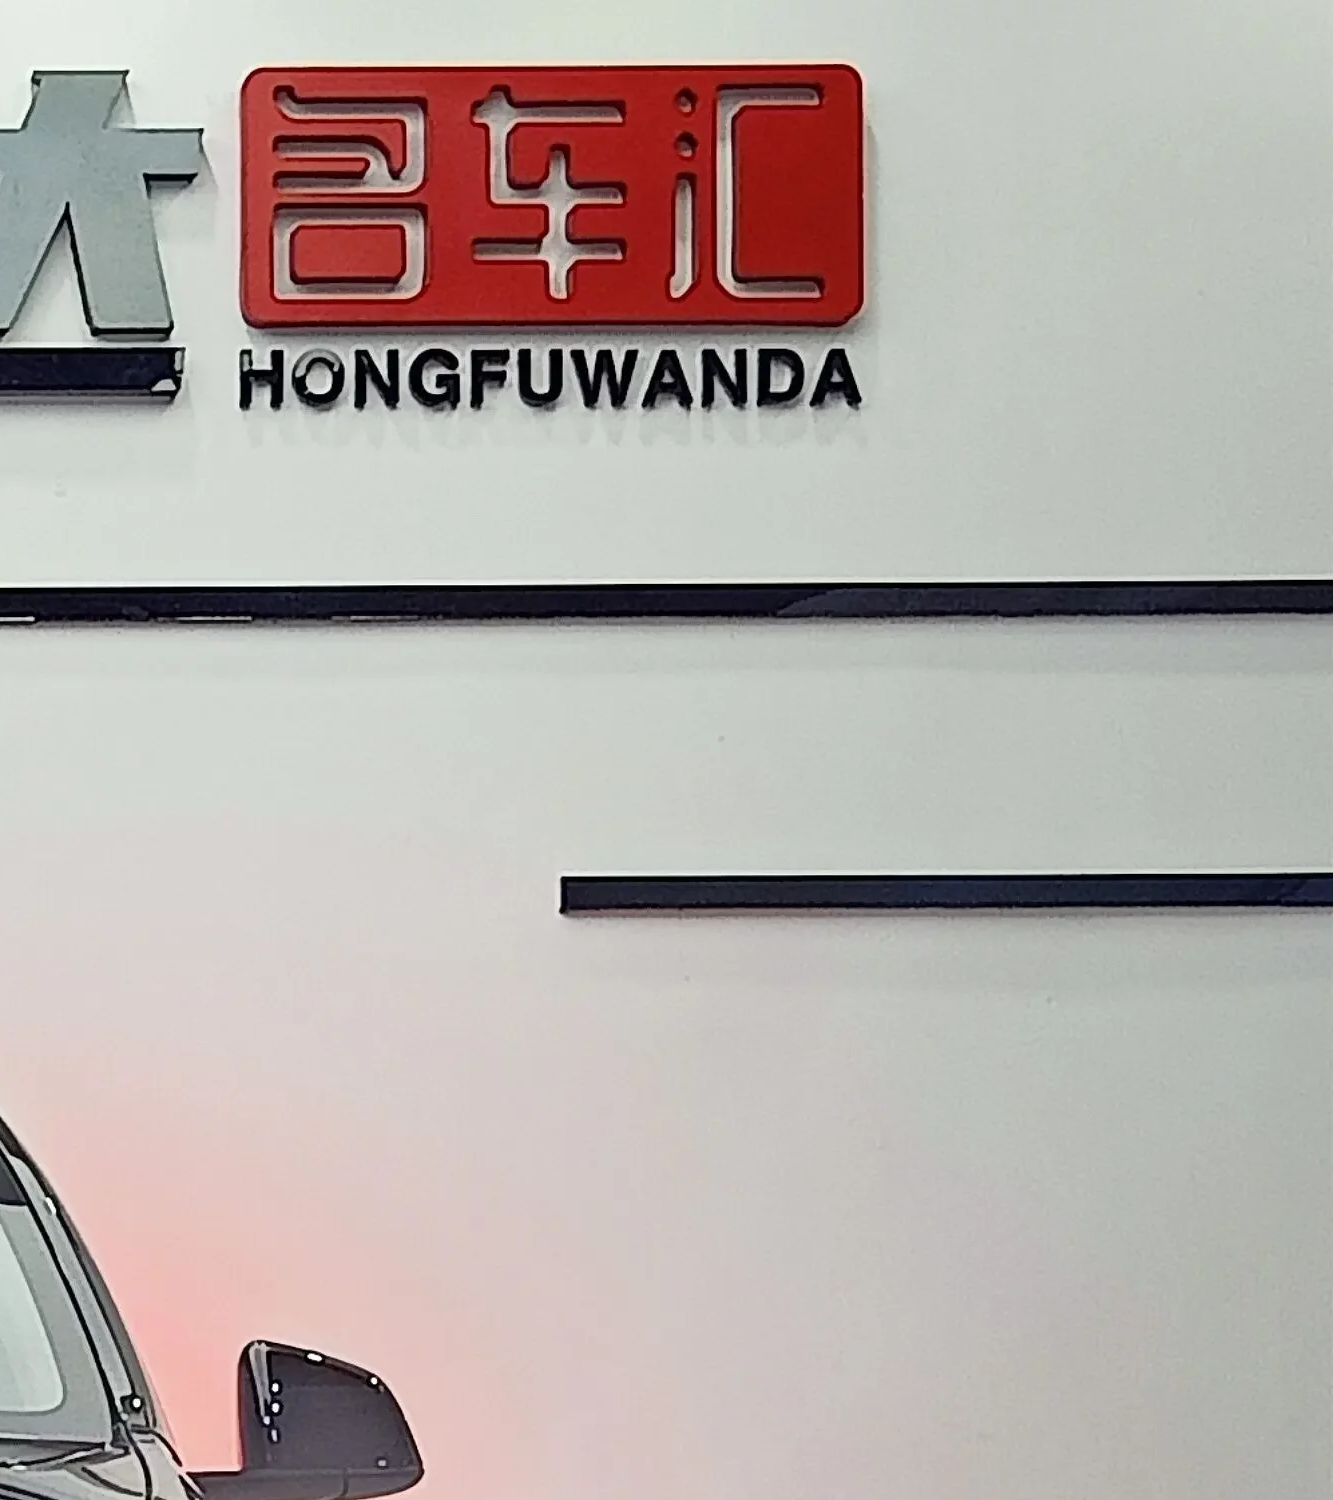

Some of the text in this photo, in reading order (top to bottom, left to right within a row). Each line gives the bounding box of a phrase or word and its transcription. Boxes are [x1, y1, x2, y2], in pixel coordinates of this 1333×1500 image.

[273, 84, 823, 300] 名车汇
[239, 347, 864, 410] HONGFUWANDA
